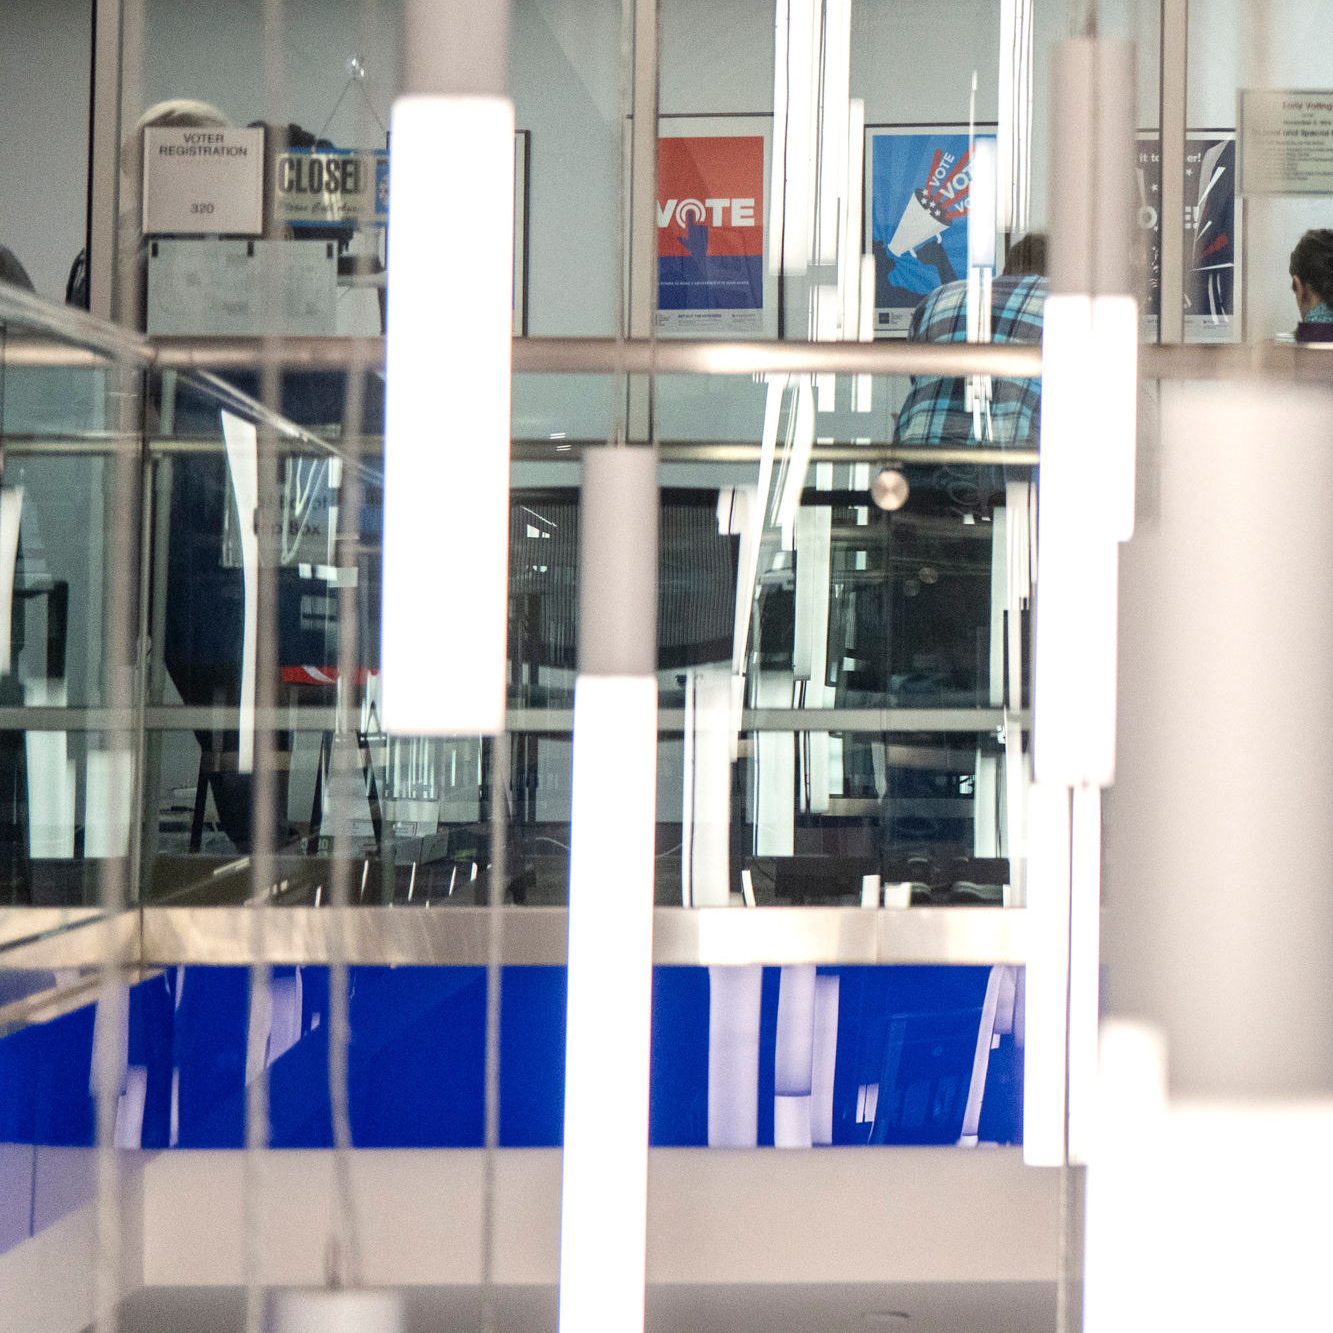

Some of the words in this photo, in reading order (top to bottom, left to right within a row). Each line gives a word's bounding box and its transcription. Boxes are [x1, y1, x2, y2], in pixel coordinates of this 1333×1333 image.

[1306, 102, 1333, 112] Voting
[183, 133, 224, 144] VOTER
[159, 146, 247, 156] REGISTRATION
[929, 152, 955, 187] VOTE
[190, 203, 215, 214] 320
[657, 198, 755, 228] VOTE
